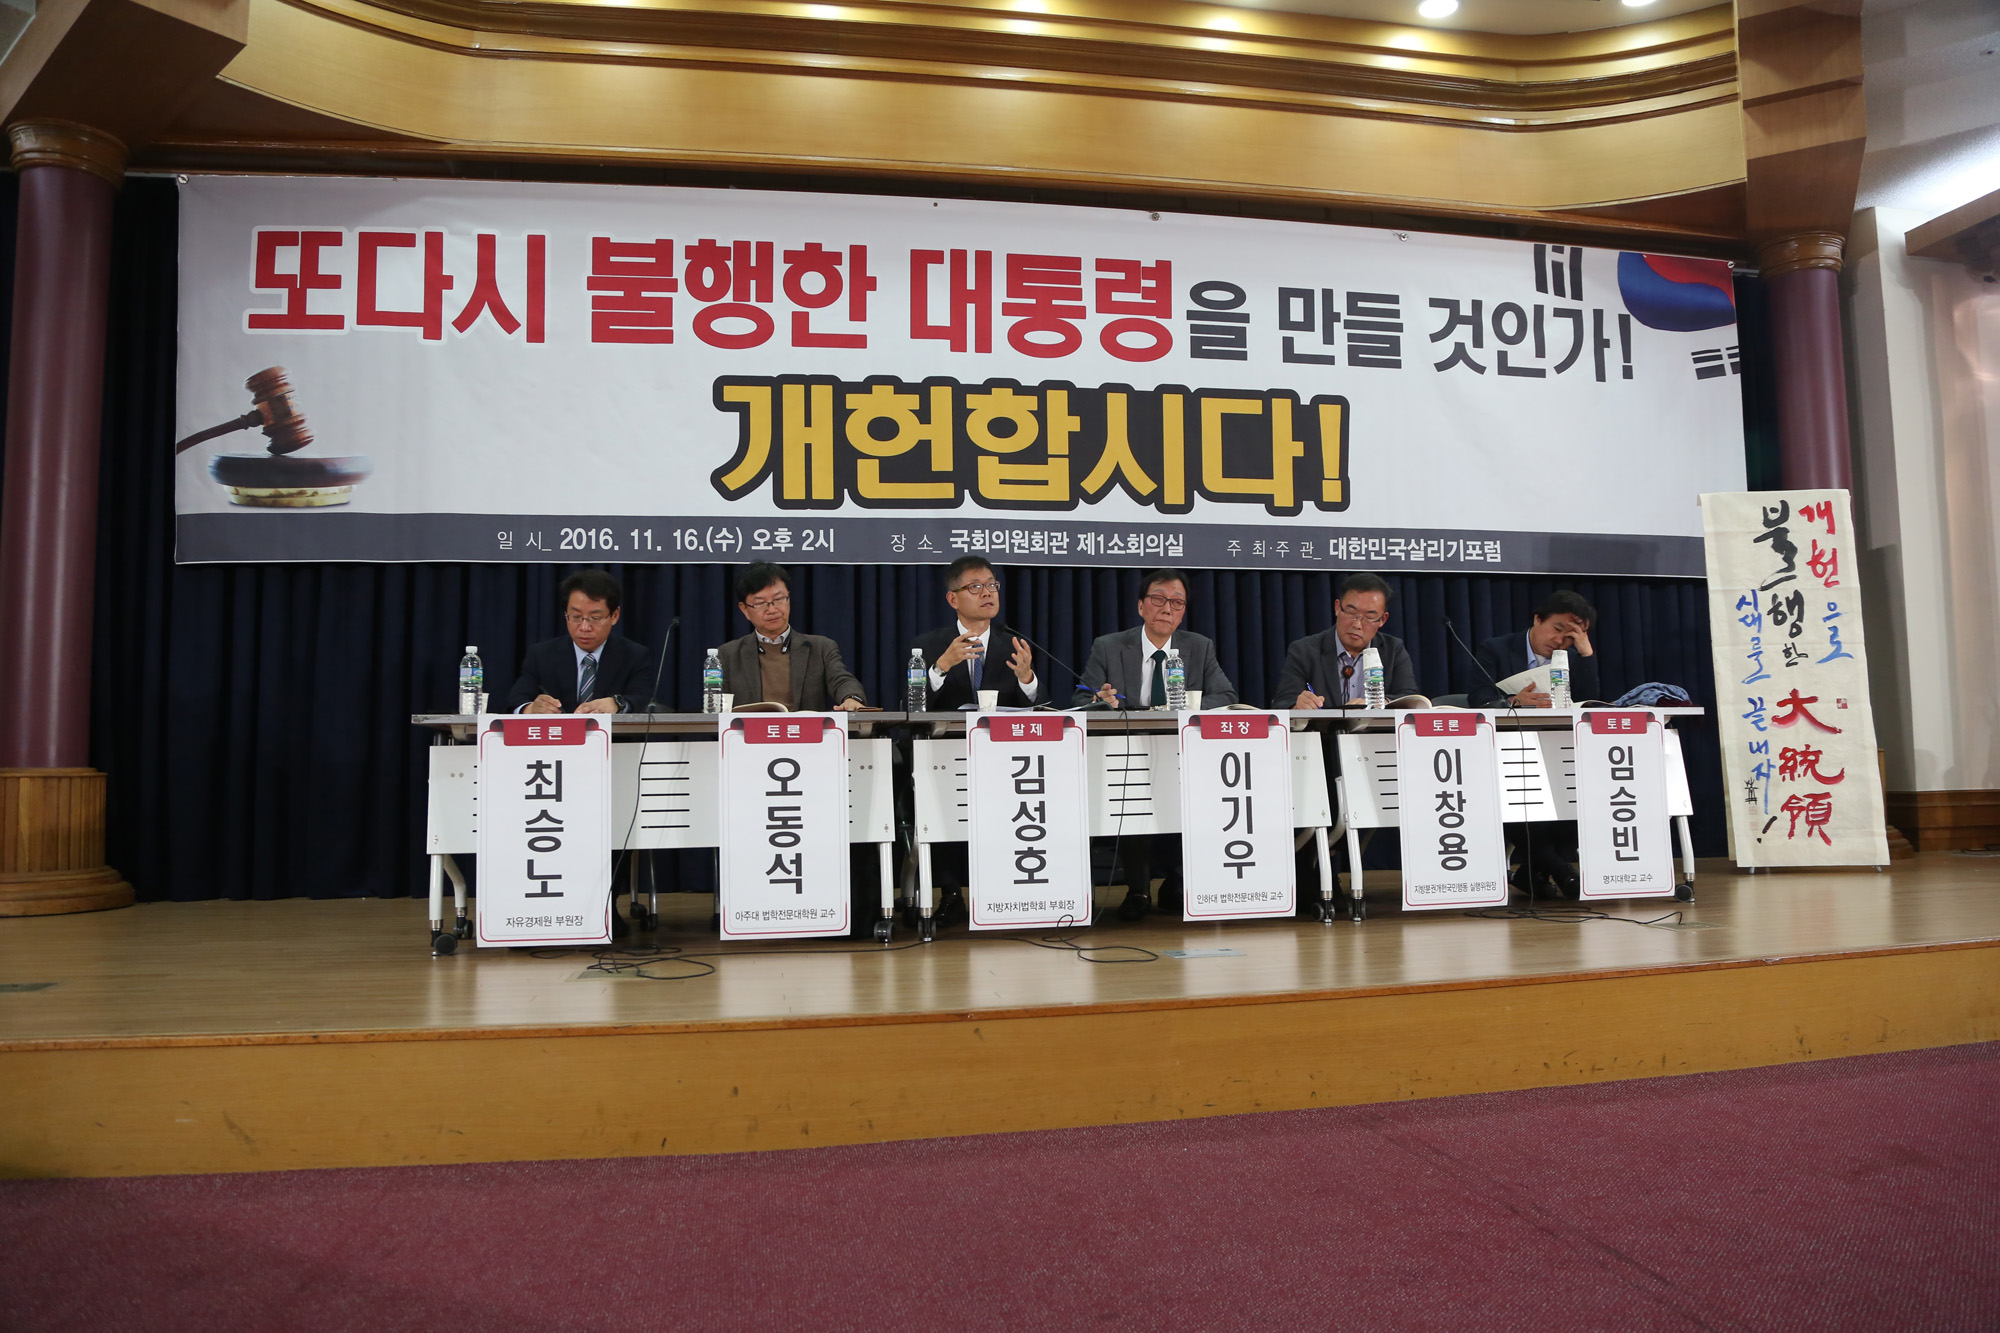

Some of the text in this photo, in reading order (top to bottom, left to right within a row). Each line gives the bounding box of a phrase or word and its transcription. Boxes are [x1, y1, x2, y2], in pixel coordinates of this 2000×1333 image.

[246, 230, 1635, 383] 또다시 불행한 대통령을 만들 것인가!
[714, 376, 1348, 514] 개헌합시다!
[560, 527, 619, 551] 2016.
[630, 528, 662, 551] 11.
[751, 527, 794, 553] 오후
[802, 528, 835, 553] 2시
[950, 529, 1069, 555] 국회의원회관
[1076, 531, 1184, 557] 제1소회의실
[1329, 536, 1502, 562] 대한민국살리기포럼
[524, 759, 564, 899] 최승노
[765, 757, 804, 895] 오동석
[1011, 754, 1049, 885] 김성호
[1220, 751, 1256, 880] 이기우
[1433, 748, 1469, 871] 이창용
[1608, 745, 1640, 862] 임승빈
[735, 907, 836, 922] 아주대 법학전문대학원 교수
[987, 899, 1075, 913] 지방자치법학회 부회장
[1196, 891, 1284, 905] 인하대 법학전문대학원 교수
[1602, 873, 1654, 885] 명지대학교 교수
[506, 914, 584, 928] 자유경제원 부원장
